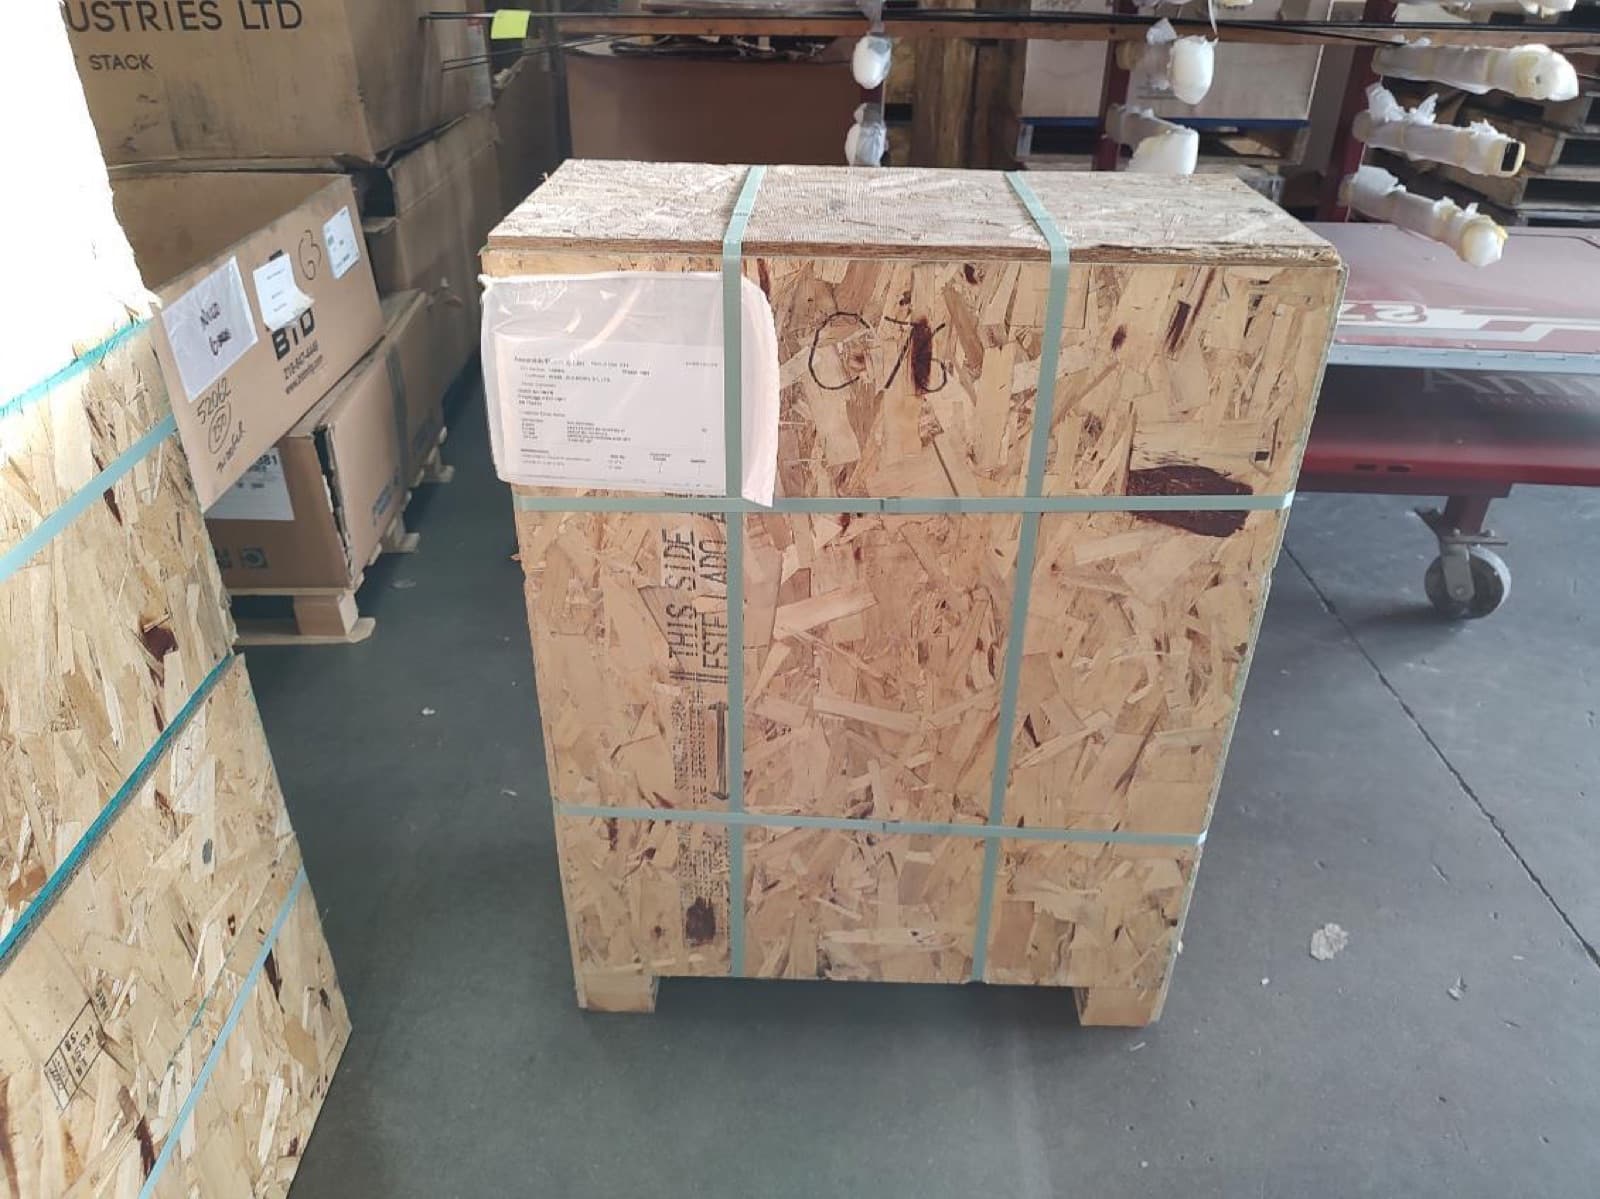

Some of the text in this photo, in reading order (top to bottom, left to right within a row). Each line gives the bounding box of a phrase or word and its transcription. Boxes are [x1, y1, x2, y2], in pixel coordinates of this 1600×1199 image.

[239, 0, 302, 29] LTD
[88, 53, 153, 71] STACK
[661, 527, 697, 592] SIDE
[665, 602, 698, 659] THIS
